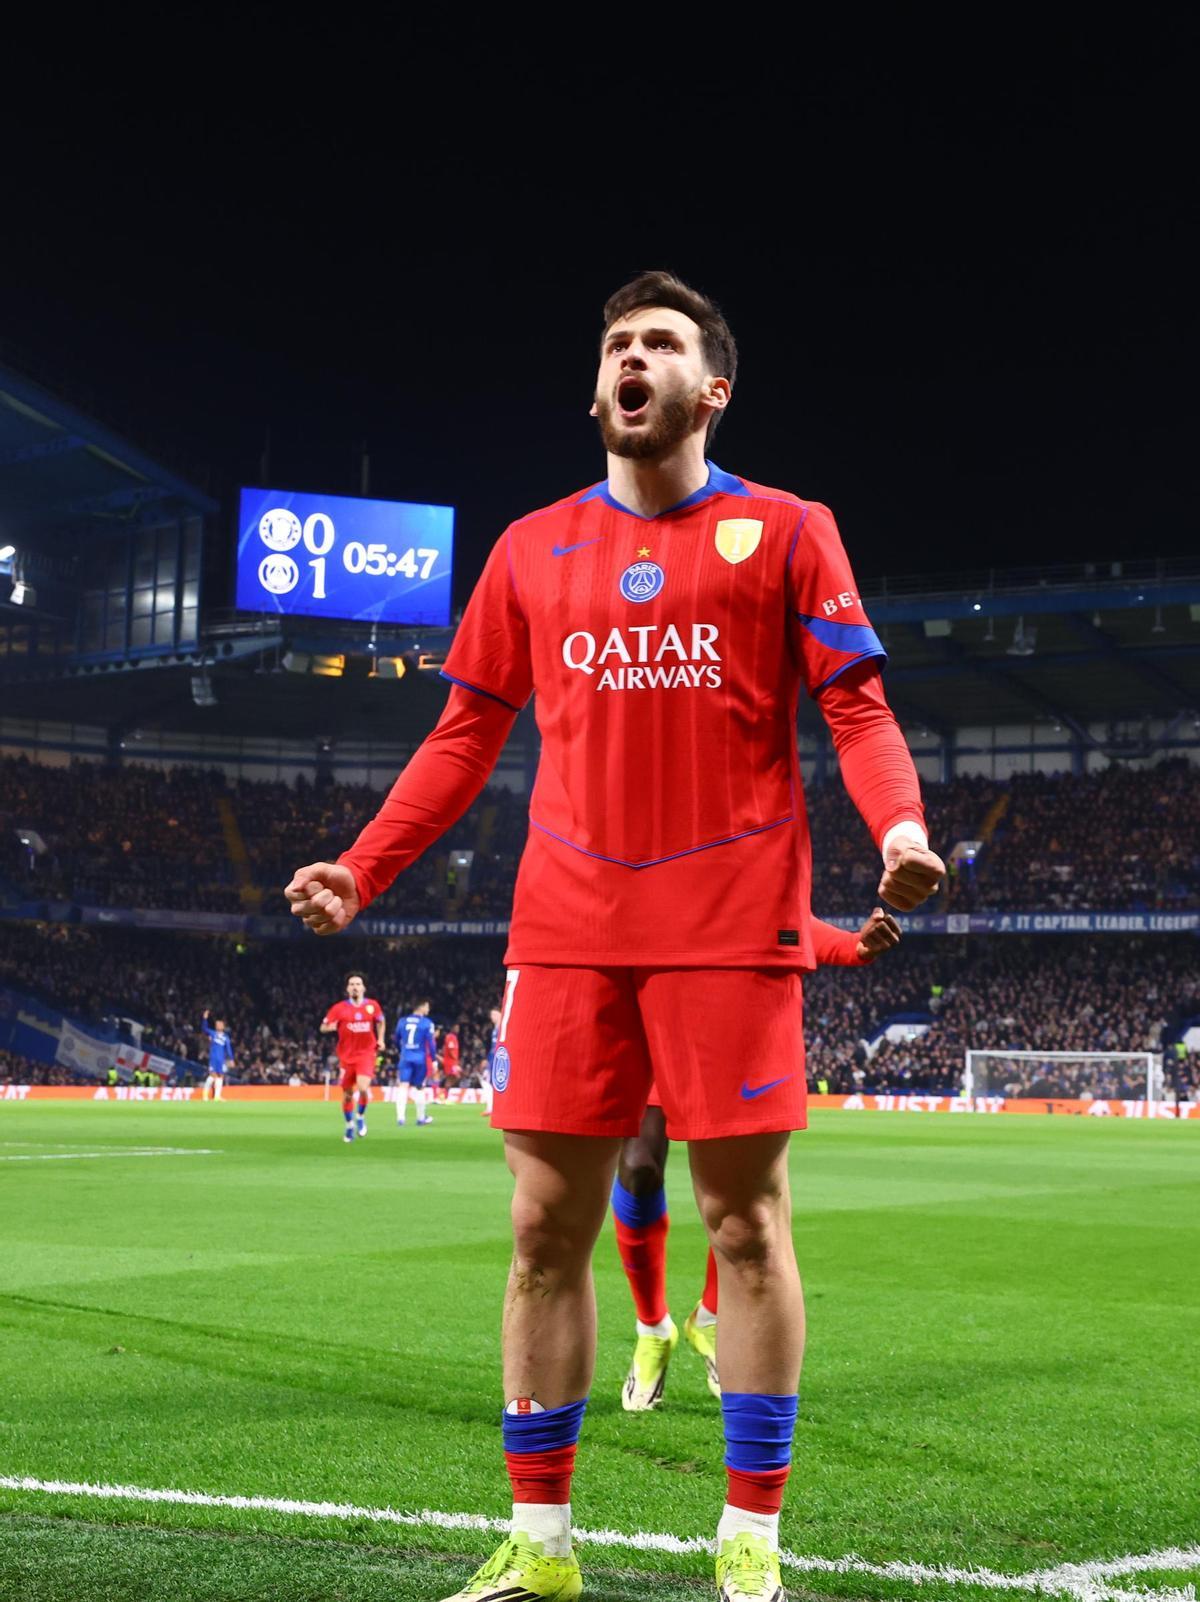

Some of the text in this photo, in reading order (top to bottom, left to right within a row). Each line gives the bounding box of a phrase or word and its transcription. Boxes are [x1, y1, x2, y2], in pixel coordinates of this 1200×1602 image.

[303, 512, 335, 556] 0
[342, 541, 439, 580] 05:47
[628, 563, 658, 575] PARIS
[308, 557, 327, 599] 1
[562, 623, 722, 675] QATAR
[596, 665, 722, 691] AIRWAYS
[499, 969, 520, 1042] 7
[405, 1023, 417, 1045] 7
[113, 1086, 195, 1100] JUST EAT
[875, 1095, 943, 1112] JUST
[1122, 1100, 1197, 1119] JUST
